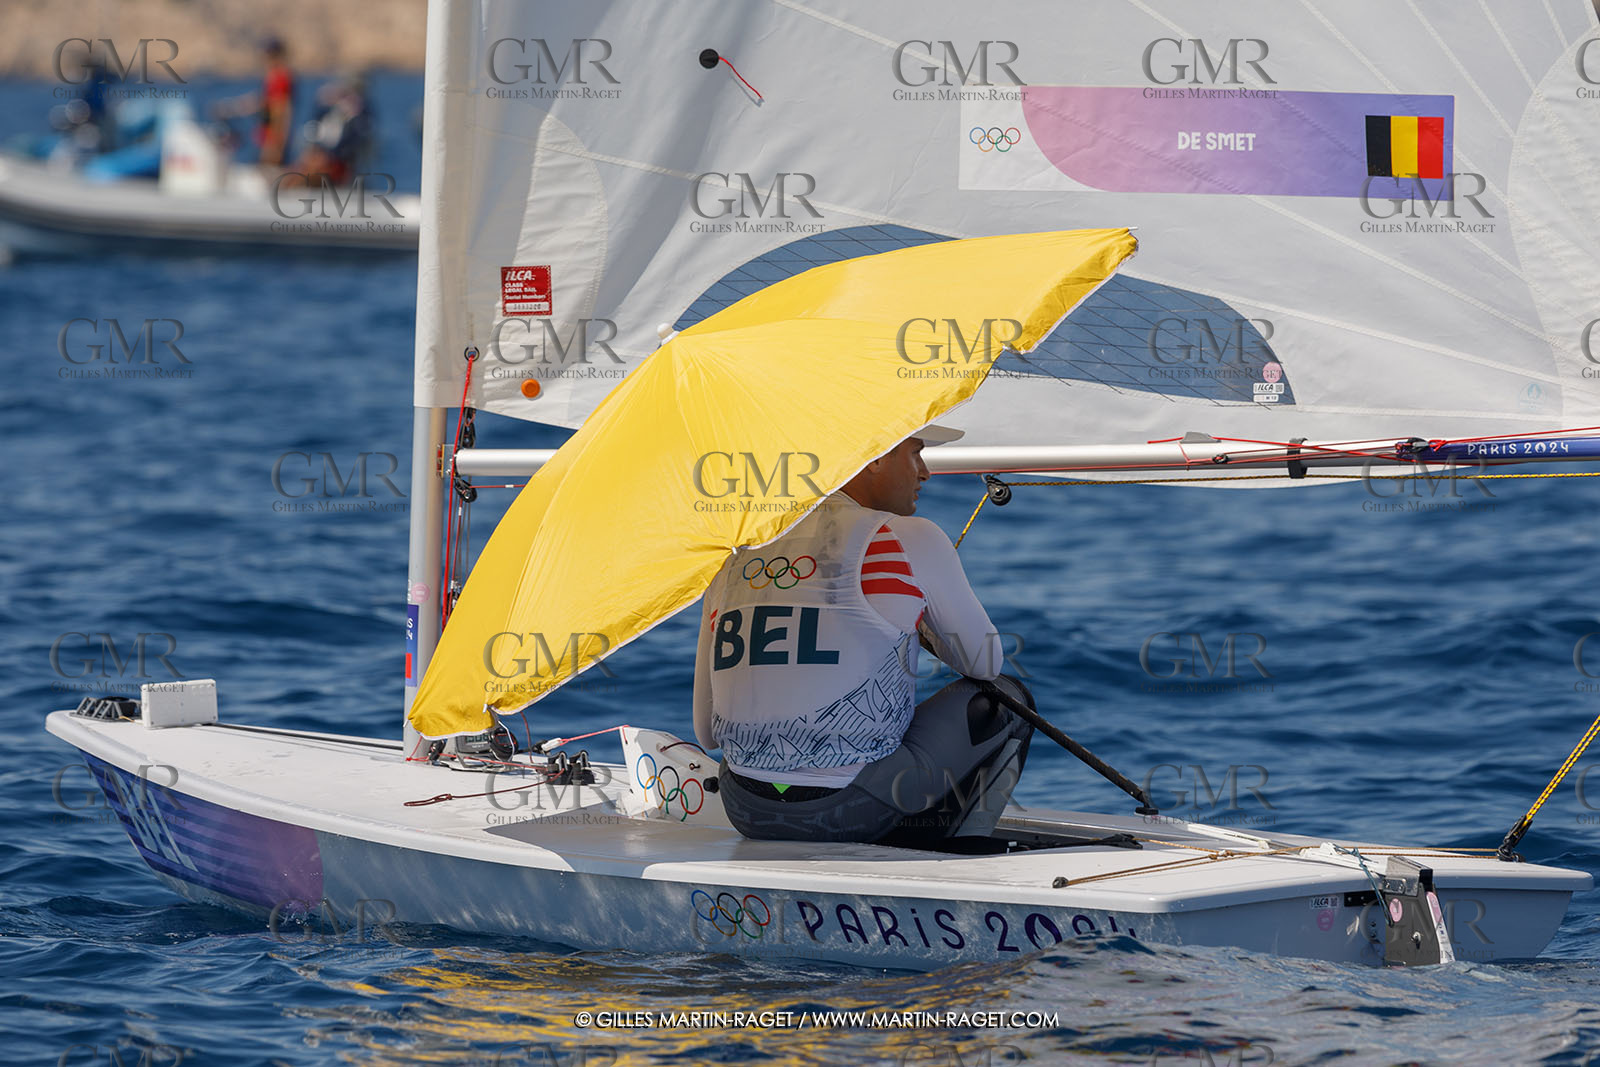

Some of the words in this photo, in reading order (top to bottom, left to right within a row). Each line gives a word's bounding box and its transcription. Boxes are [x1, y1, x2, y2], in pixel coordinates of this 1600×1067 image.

[1178, 132, 1201, 150] DE
[1206, 132, 1256, 151] SMET
[505, 270, 532, 281] ILCA
[1257, 383, 1274, 391] ILCA
[1467, 442, 1517, 455] PARIS
[1523, 442, 1569, 454] 2024
[714, 606, 840, 671] BEL
[796, 900, 966, 951] PARIS
